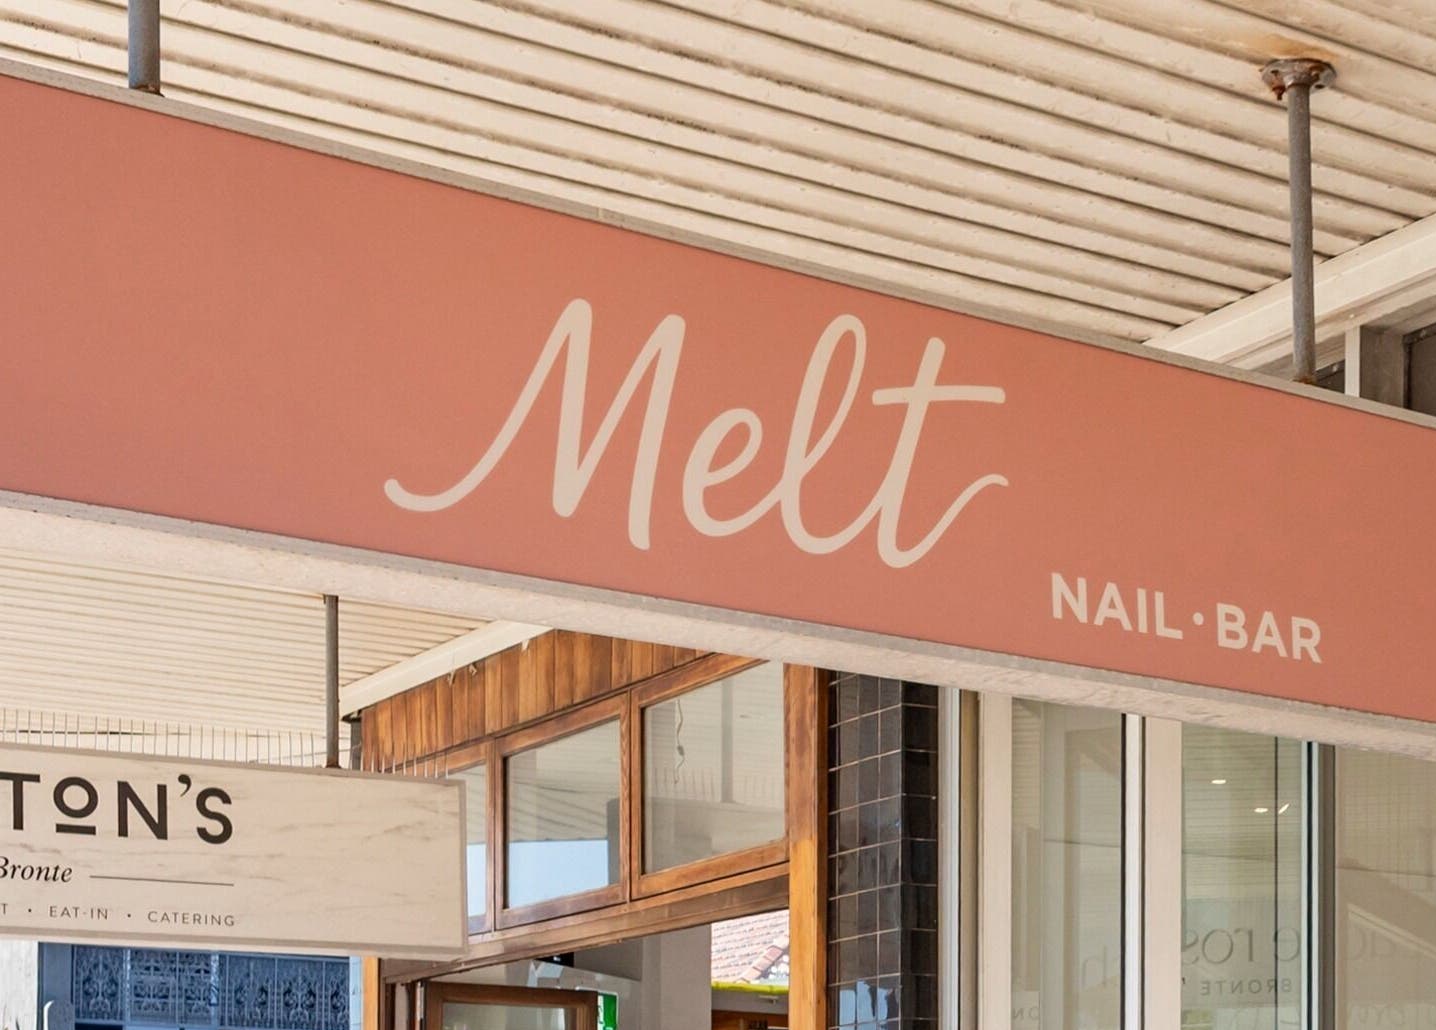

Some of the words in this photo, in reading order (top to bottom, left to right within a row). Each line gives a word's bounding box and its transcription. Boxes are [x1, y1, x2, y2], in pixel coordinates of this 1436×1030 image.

[384, 298, 1009, 568] Melt
[1051, 572, 1183, 640] NAIL
[1216, 602, 1322, 664] BAR
[0, 856, 73, 883] Bronte
[49, 905, 108, 920] EAT-IN
[147, 911, 236, 926] CATERING
